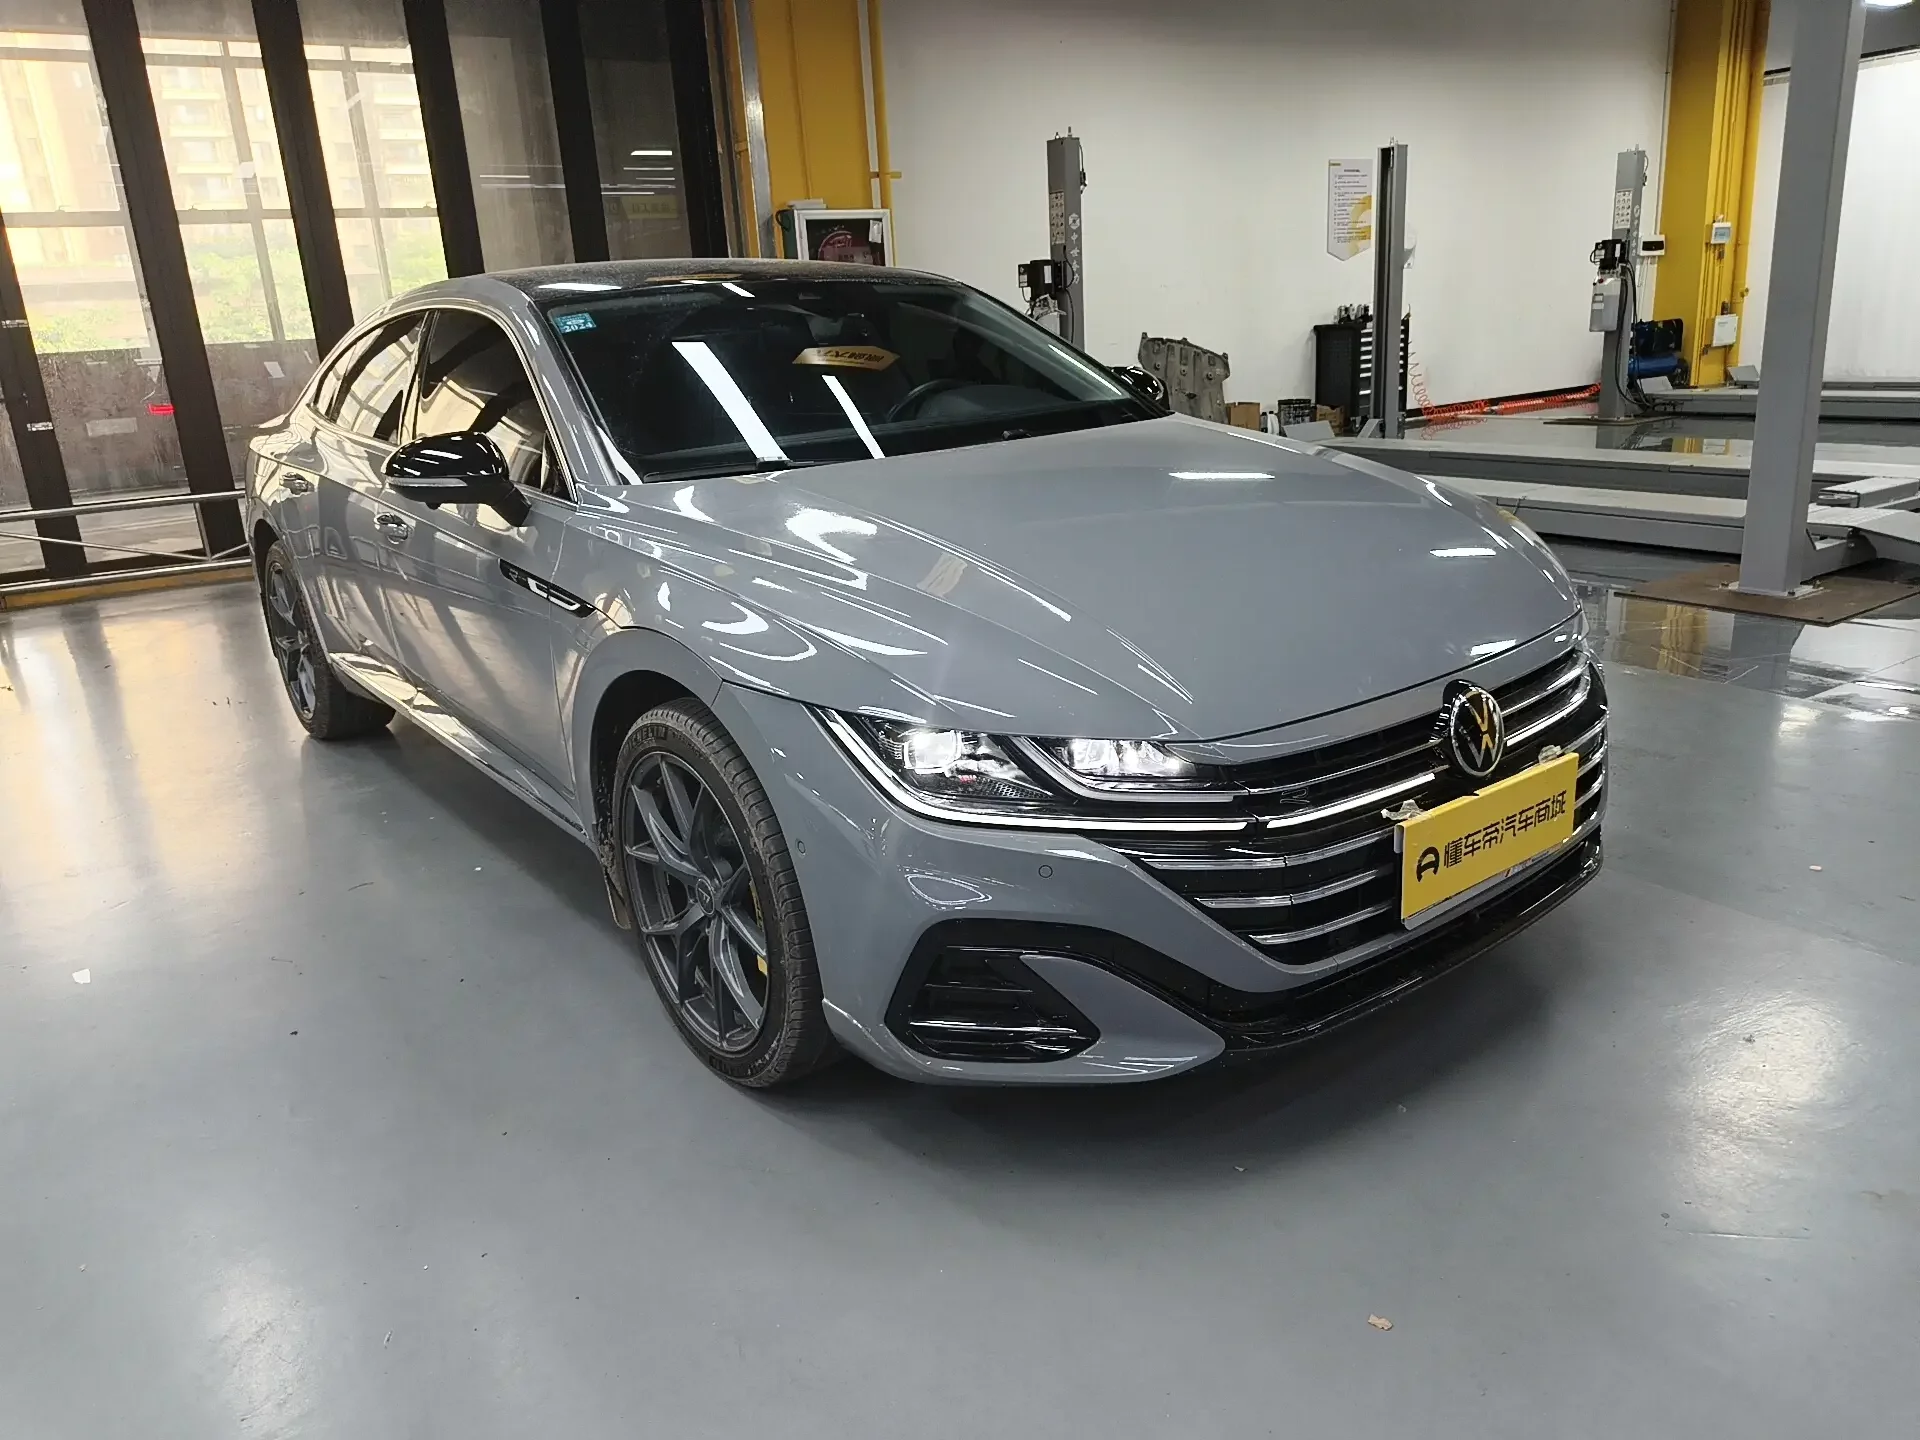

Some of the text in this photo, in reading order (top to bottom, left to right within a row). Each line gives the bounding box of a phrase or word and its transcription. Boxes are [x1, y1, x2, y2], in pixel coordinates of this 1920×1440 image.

[565, 322, 593, 333] 2024
[1443, 790, 1567, 868] 懂车帝汽车商城
